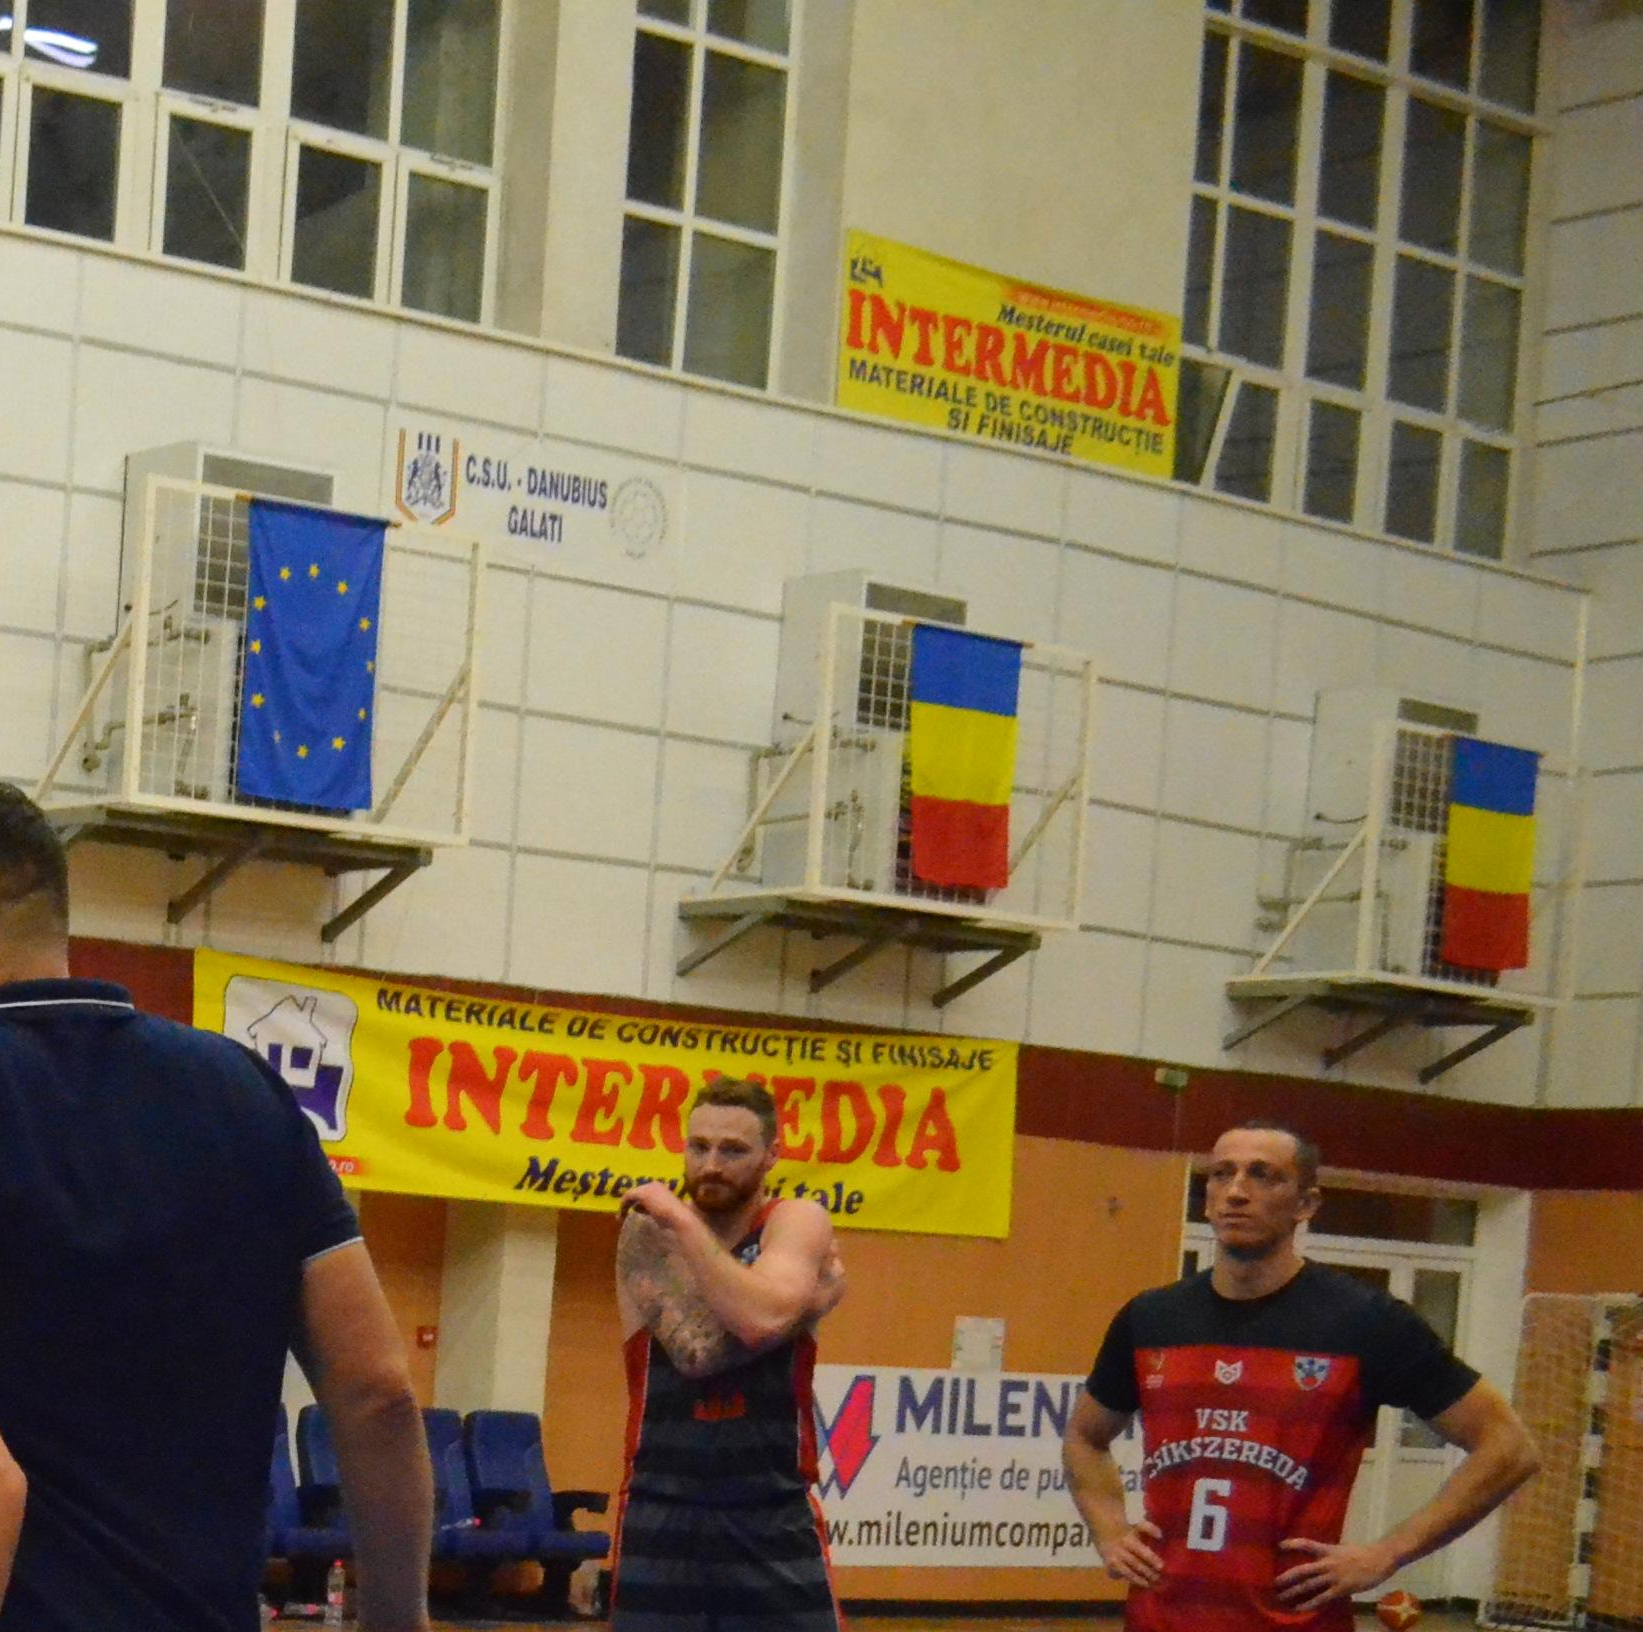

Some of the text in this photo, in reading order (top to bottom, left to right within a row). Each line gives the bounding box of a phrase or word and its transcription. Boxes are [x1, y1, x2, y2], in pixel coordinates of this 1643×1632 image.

[846, 288, 1172, 428] INTERMEDIA
[848, 358, 978, 408] MATERIALE
[985, 391, 1013, 417] DE
[977, 415, 1076, 457] FINISAJE
[527, 467, 609, 510] DANUBIUS
[507, 506, 563, 543] GALATI
[376, 987, 994, 1072] MATERIALE DE CONSTRUCȚIE ȘI FINISAJE
[404, 1036, 962, 1173] INTEREDIA
[515, 1155, 689, 1202] Meșter
[895, 1375, 1142, 1441] MILEN
[1195, 1407, 1250, 1432] VSK
[895, 1456, 993, 1500] Agenție
[999, 1459, 1030, 1491] de
[1186, 1477, 1232, 1552] 6
